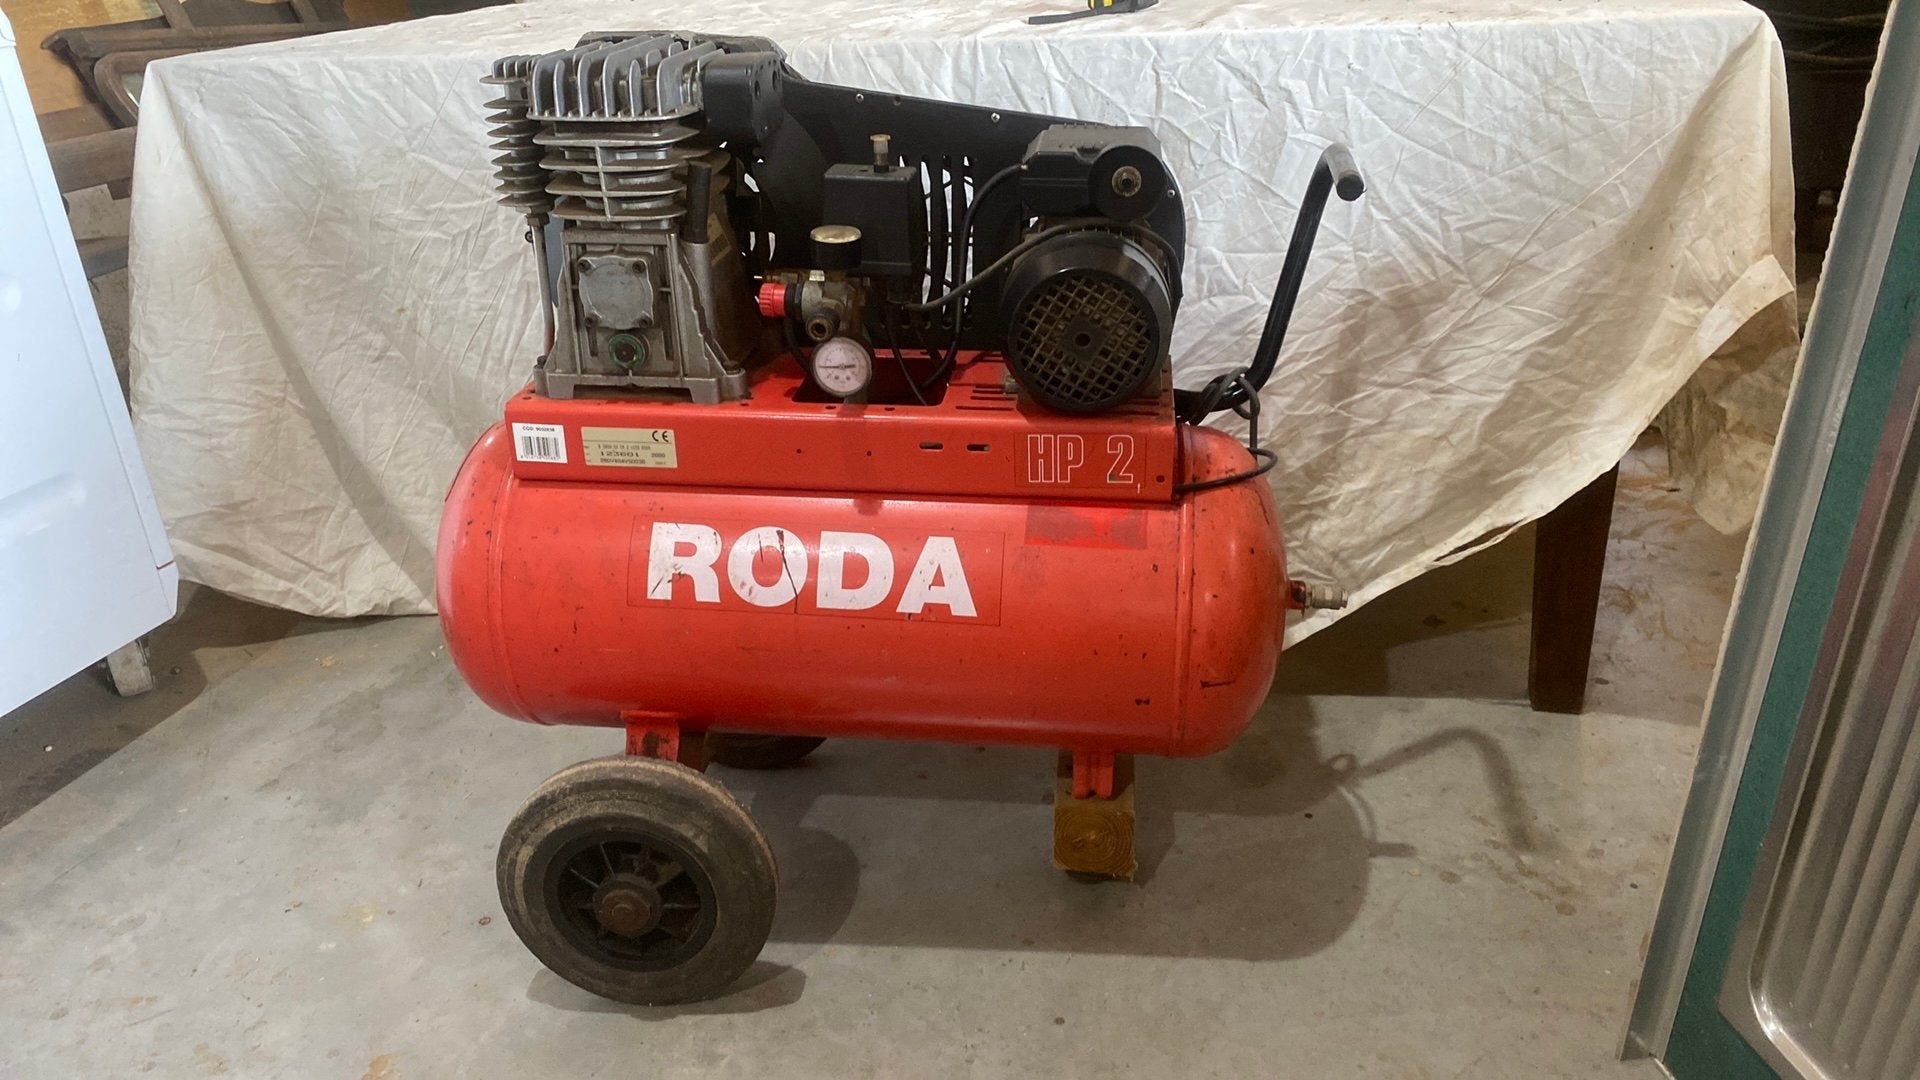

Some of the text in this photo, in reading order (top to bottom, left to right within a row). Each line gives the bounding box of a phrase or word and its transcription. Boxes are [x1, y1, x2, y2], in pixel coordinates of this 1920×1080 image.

[652, 430, 669, 442] CE
[1028, 434, 1135, 484] HP 2
[647, 521, 978, 617] RODA
